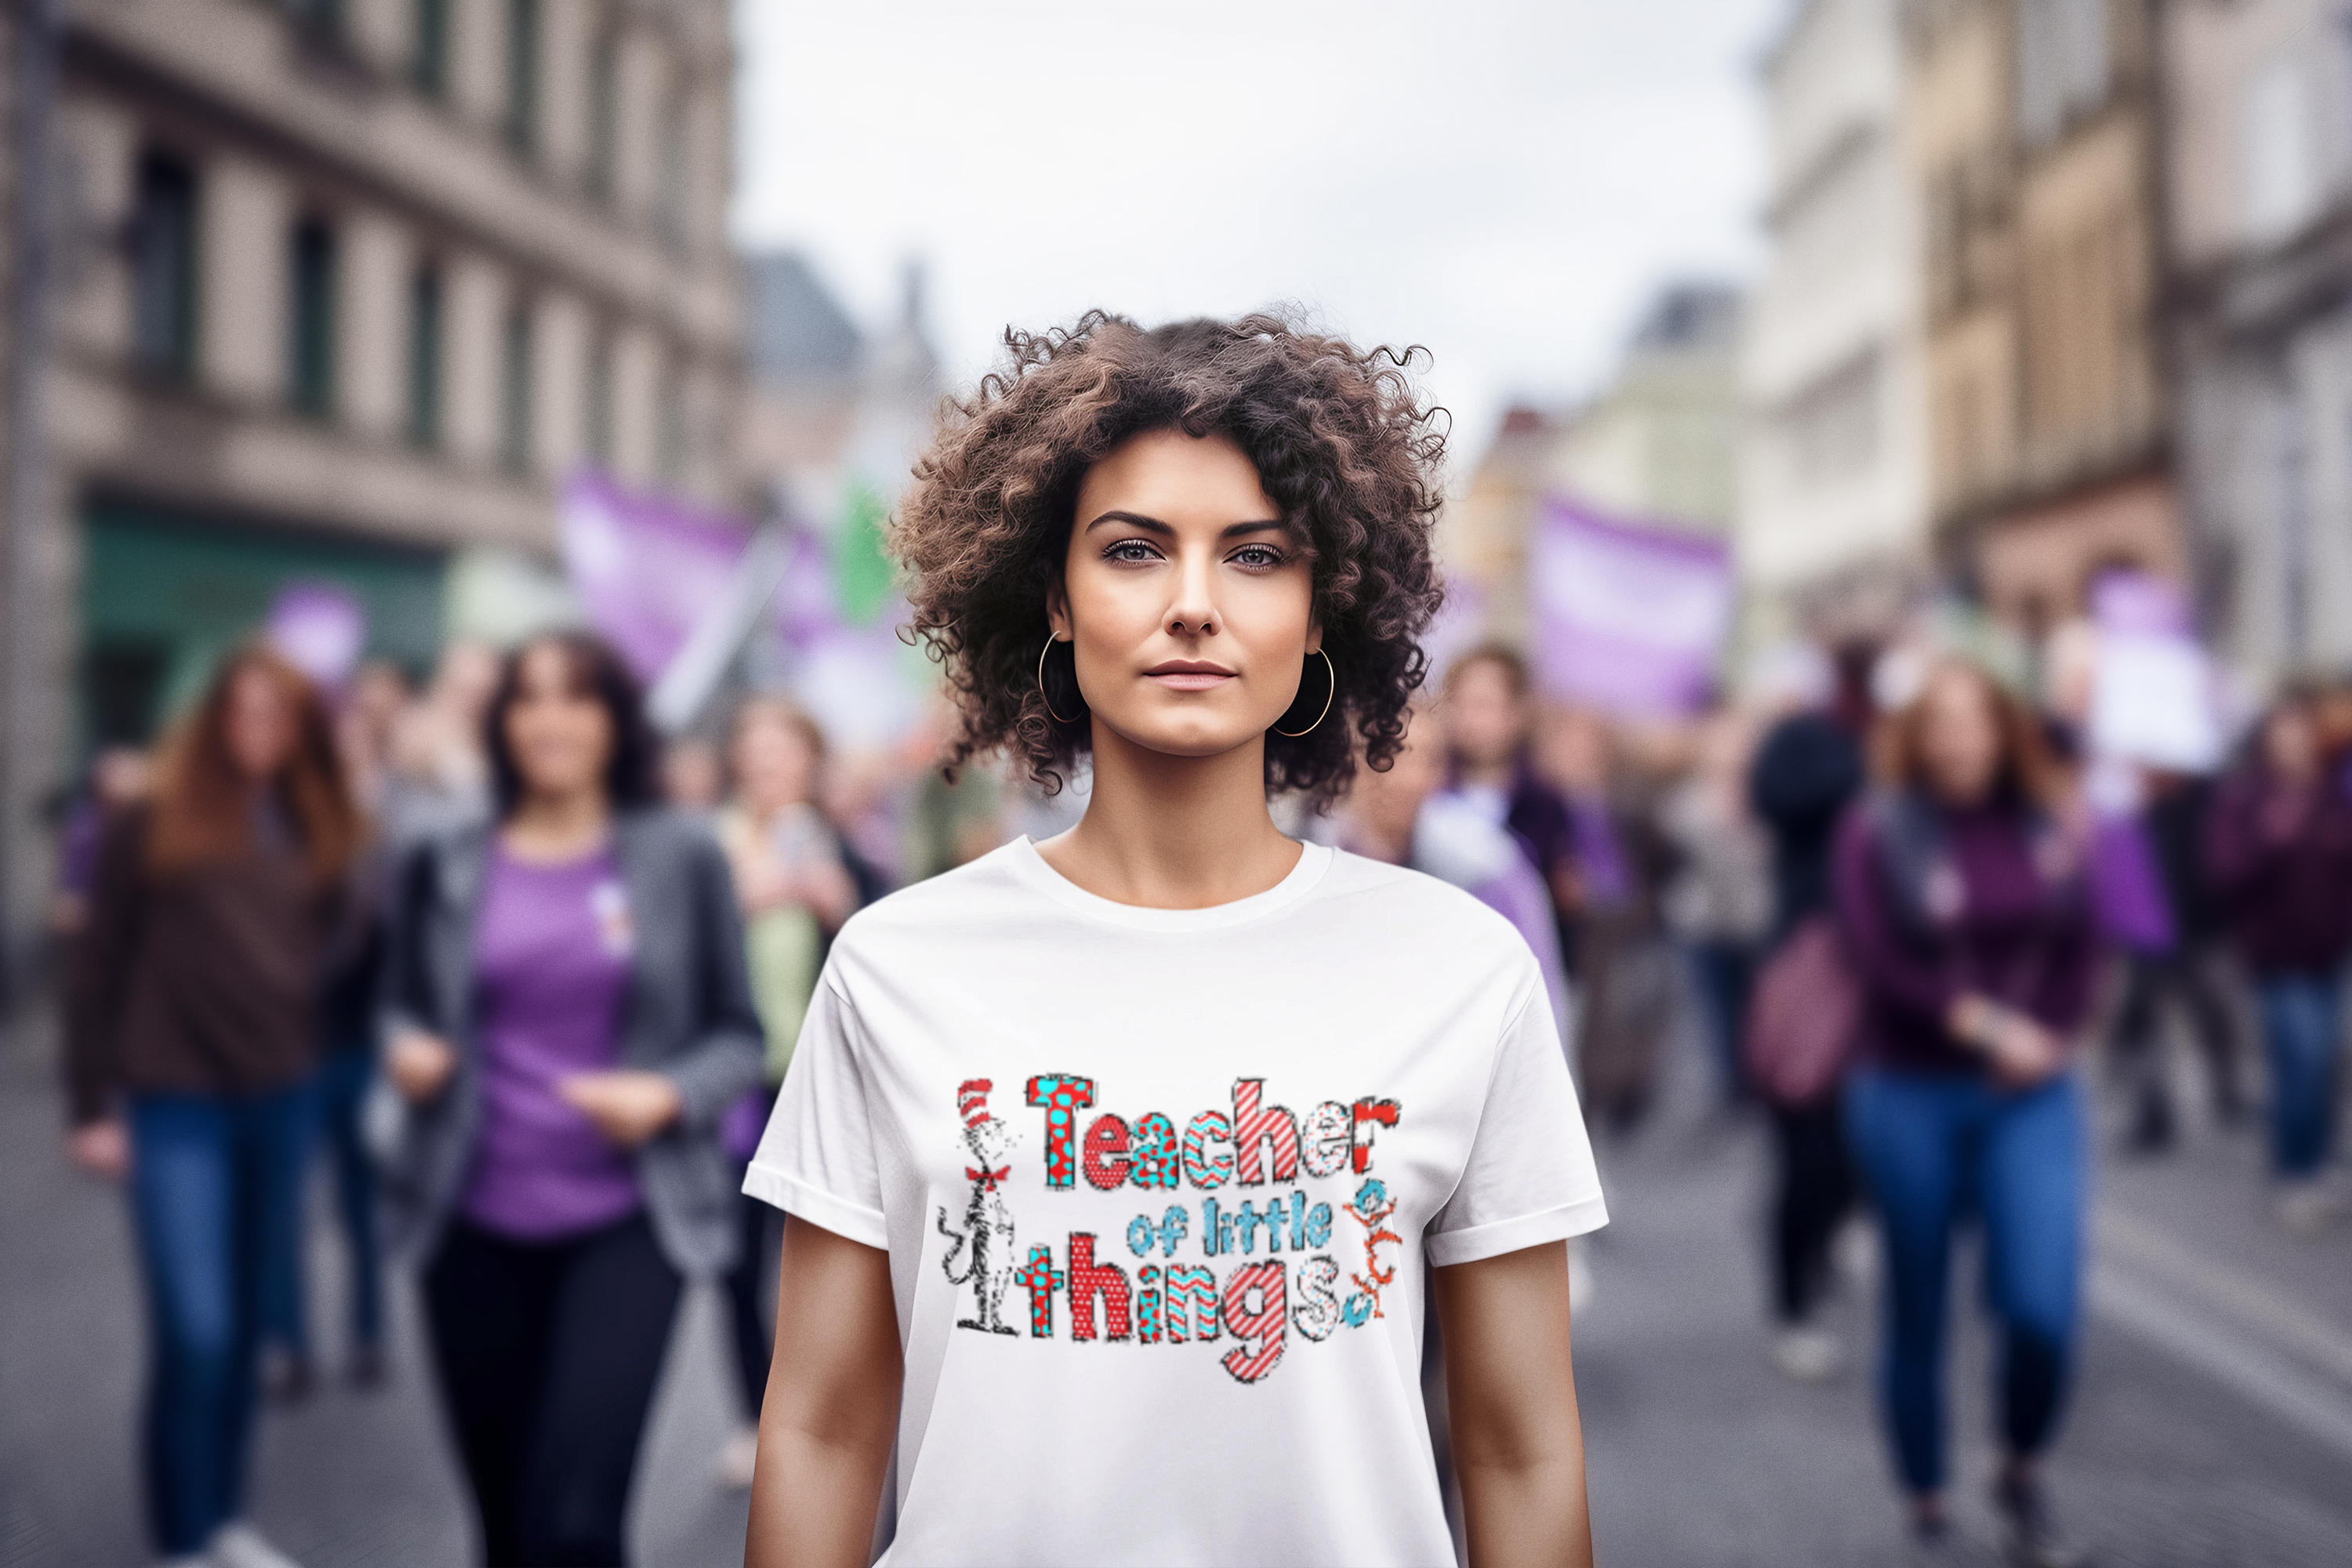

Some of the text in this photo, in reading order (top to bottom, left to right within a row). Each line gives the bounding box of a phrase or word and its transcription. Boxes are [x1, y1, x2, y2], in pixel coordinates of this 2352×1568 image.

[1025, 1073, 1402, 1190] Teacher
[1127, 1191, 1332, 1257] of little
[1014, 1231, 1339, 1385] things
